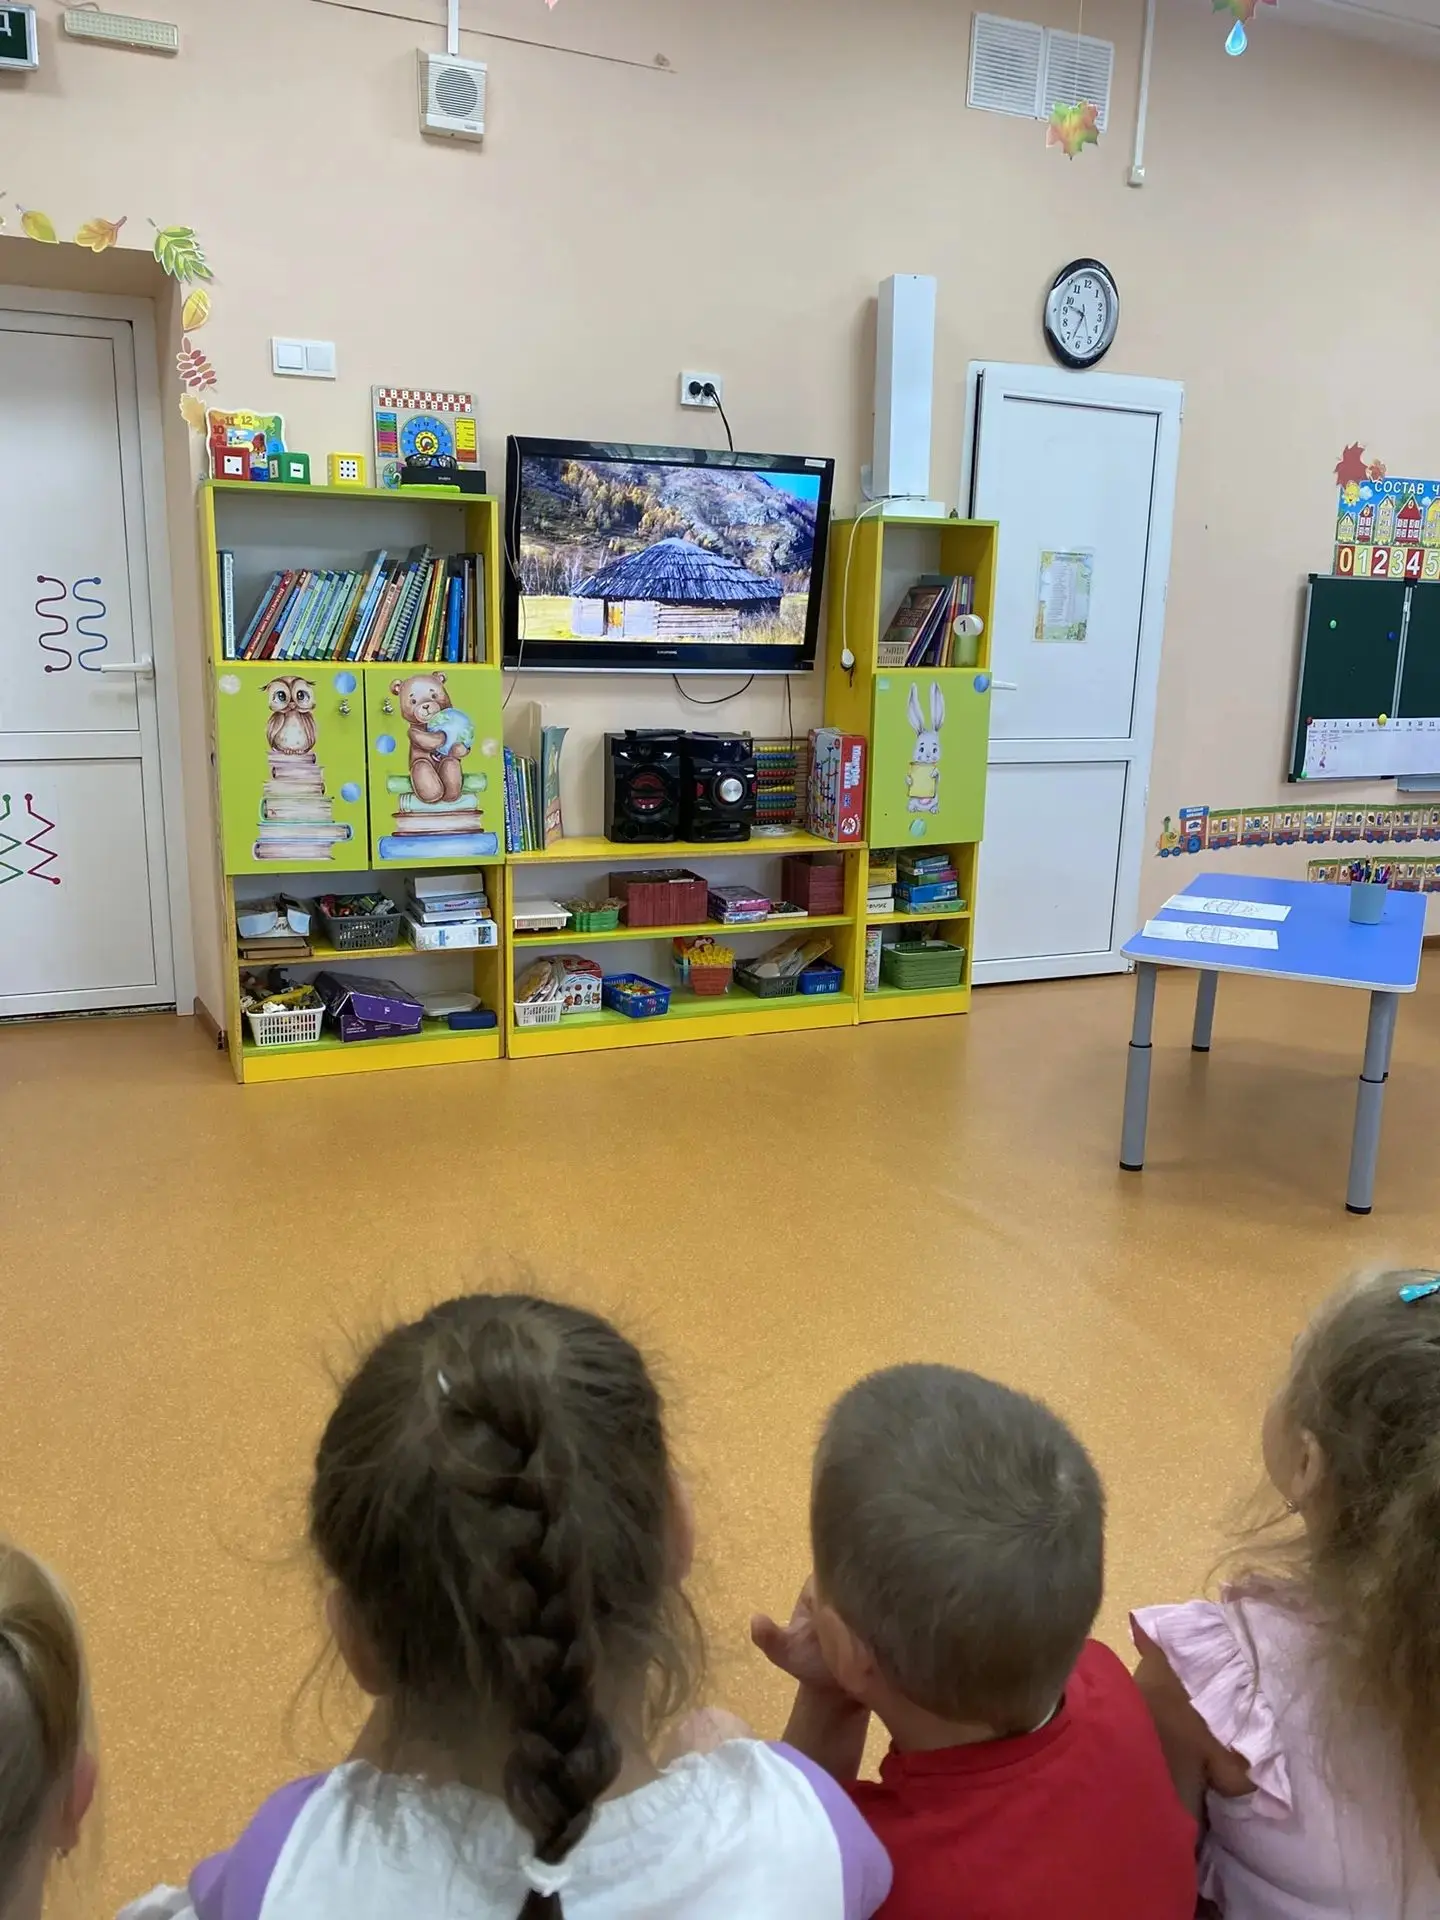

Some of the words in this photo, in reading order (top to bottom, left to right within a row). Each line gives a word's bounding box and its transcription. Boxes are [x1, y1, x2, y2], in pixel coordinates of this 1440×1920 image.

[1084, 280, 1092, 289] 12
[1073, 285, 1080, 294] 11
[1095, 289, 1099, 298] 1
[1066, 297, 1074, 305] 10
[1063, 307, 1068, 315] 9
[1098, 303, 1103, 312] 2
[1097, 314, 1102, 322] 3
[1063, 319, 1068, 327] 8
[1093, 325, 1098, 334] 4
[1066, 332, 1071, 340] 7
[1087, 336, 1092, 345] 5
[1075, 341, 1080, 349] 6
[225, 417, 235, 426] 11
[241, 416, 253, 425] 12
[213, 426, 224, 434] 10
[1375, 481, 1424, 494] СОСТАВ
[1340, 547, 1353, 572] 0
[1358, 548, 1368, 574] 1
[1373, 549, 1388, 574] 2
[1392, 549, 1404, 575] 3
[1406, 551, 1420, 575] 4
[1425, 551, 1439, 576] 5
[960, 620, 966, 632] 1
[1255, 819, 1261, 829] В
